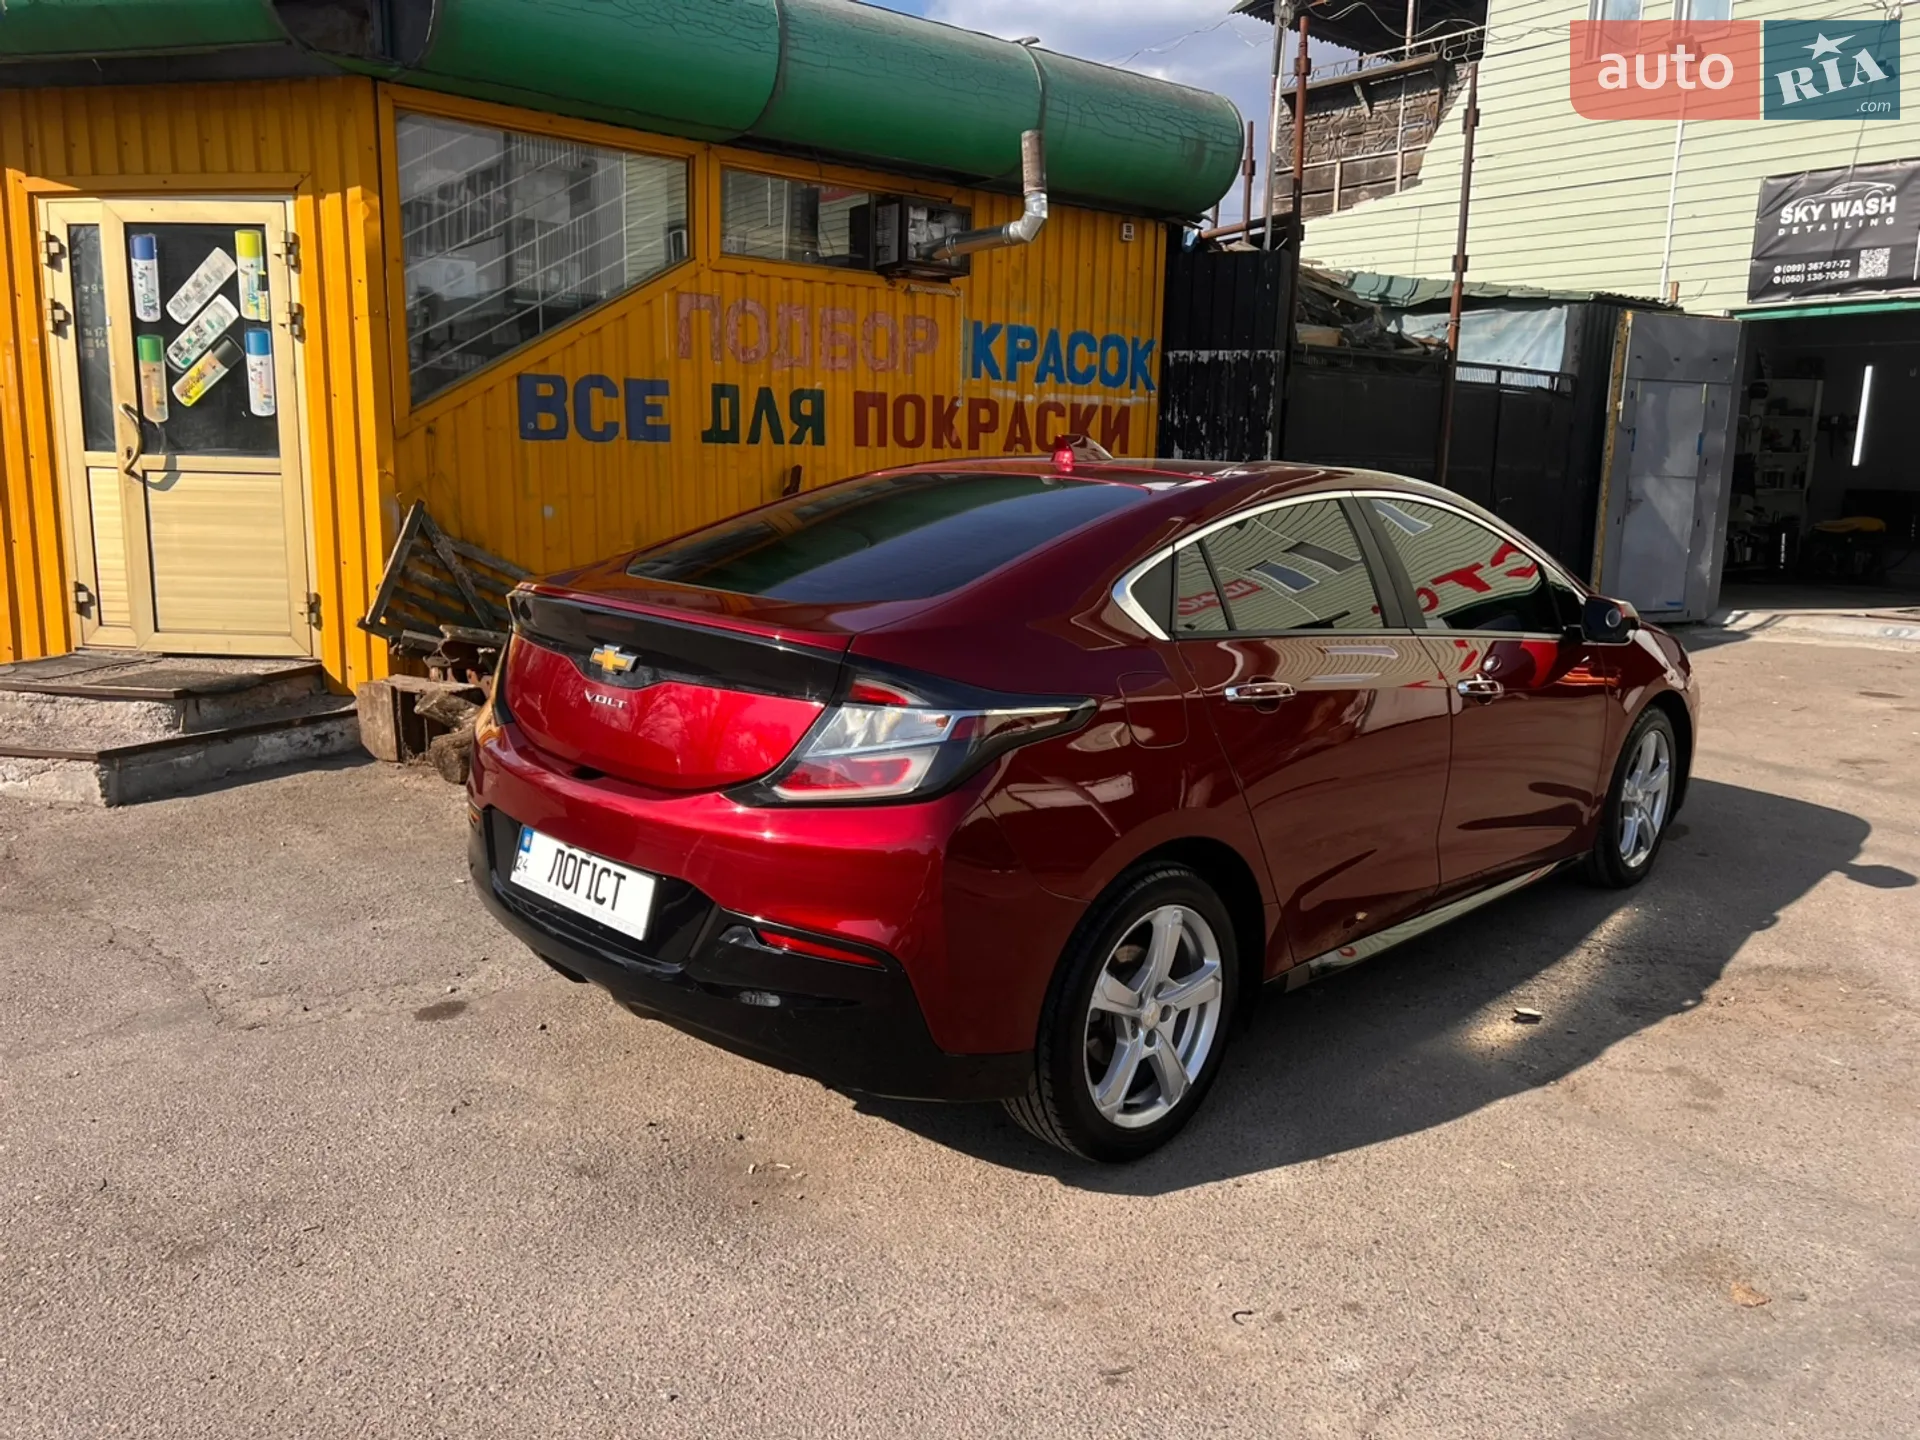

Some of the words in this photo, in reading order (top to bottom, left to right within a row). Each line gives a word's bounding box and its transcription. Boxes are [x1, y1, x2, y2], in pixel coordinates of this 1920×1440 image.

[1778, 218, 1895, 236] DETAILING
[1780, 204, 1826, 225] SKY
[1831, 197, 1896, 218] WASH
[675, 291, 939, 374] ПОДБОР
[970, 319, 1158, 391] КРАСОК
[517, 373, 670, 442] ВСЕ
[701, 383, 825, 446] ДЛЯ
[853, 390, 1131, 454] ПОКРАСКИ
[585, 690, 627, 708] VOLT
[547, 848, 626, 911] ЛОГІСТ
